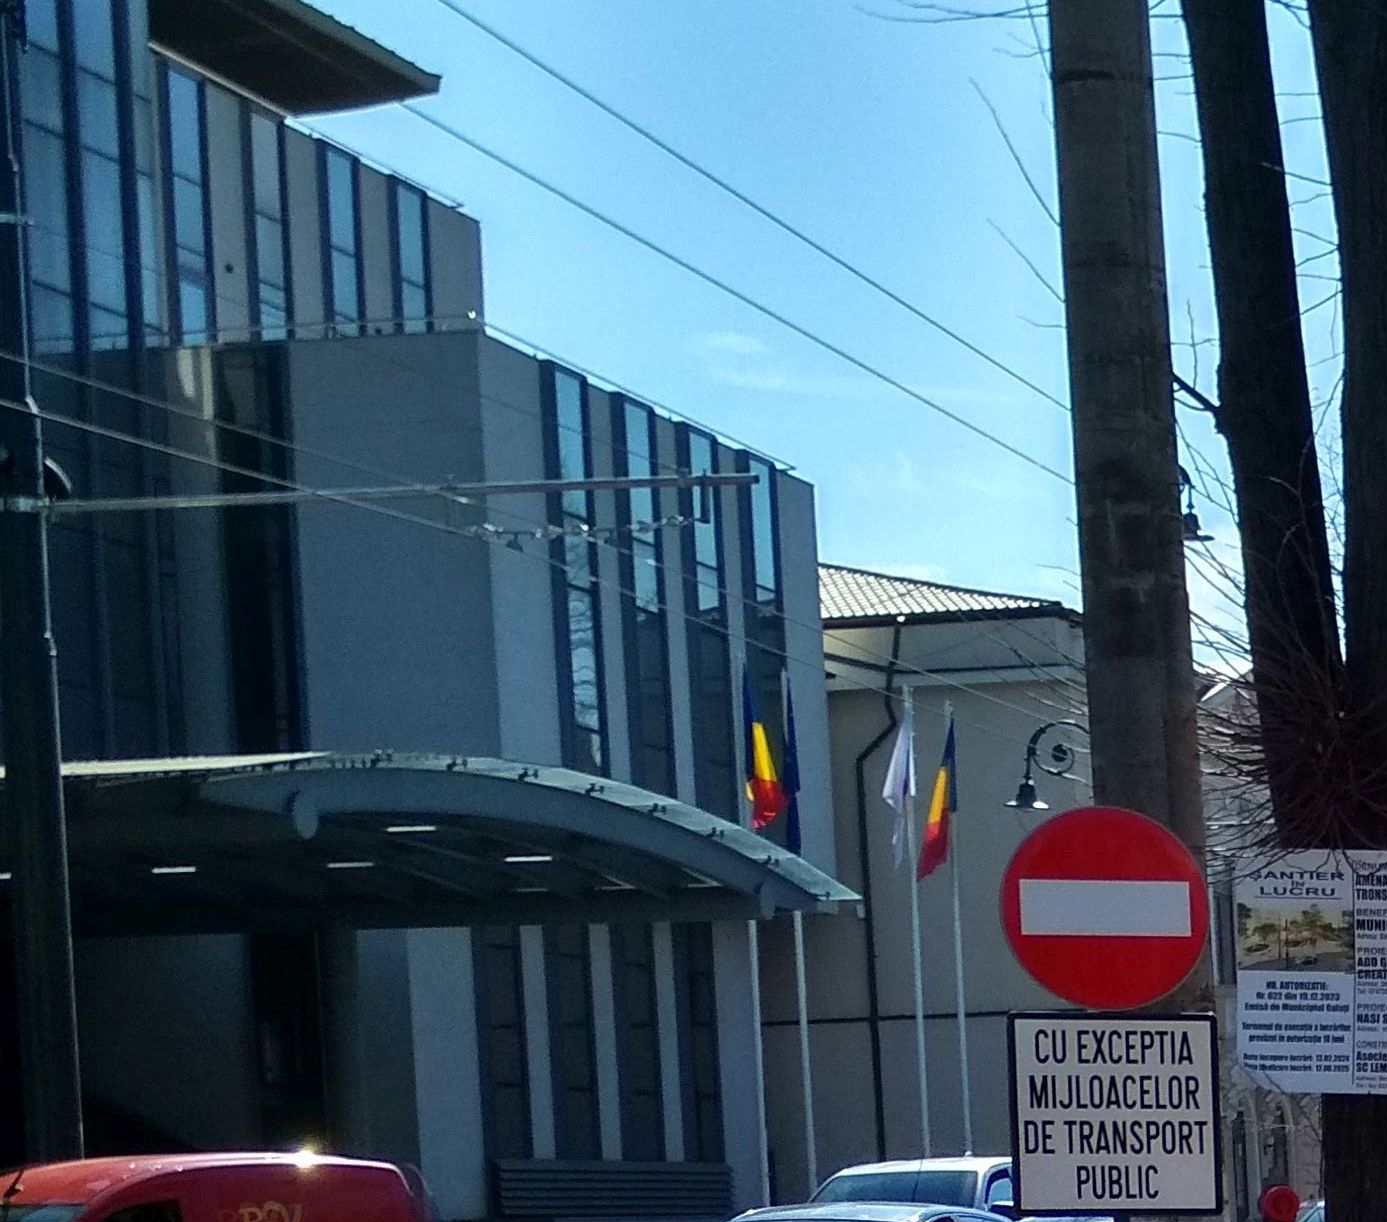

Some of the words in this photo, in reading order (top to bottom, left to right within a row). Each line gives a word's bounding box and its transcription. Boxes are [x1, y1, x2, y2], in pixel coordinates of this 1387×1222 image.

[1260, 886, 1336, 897] LUCRU
[1357, 957, 1378, 968] ADD
[1356, 1014, 1380, 1024] NASI
[1034, 1029, 1067, 1064] CU
[1076, 1029, 1194, 1065] EXCEPTIA
[1355, 1062, 1369, 1073] SC
[1028, 1074, 1201, 1110] MIJLOACELOR
[1023, 1120, 1056, 1155] DE
[1063, 1120, 1208, 1155] TRANSPORT
[1076, 1165, 1160, 1200] PUBLIC
